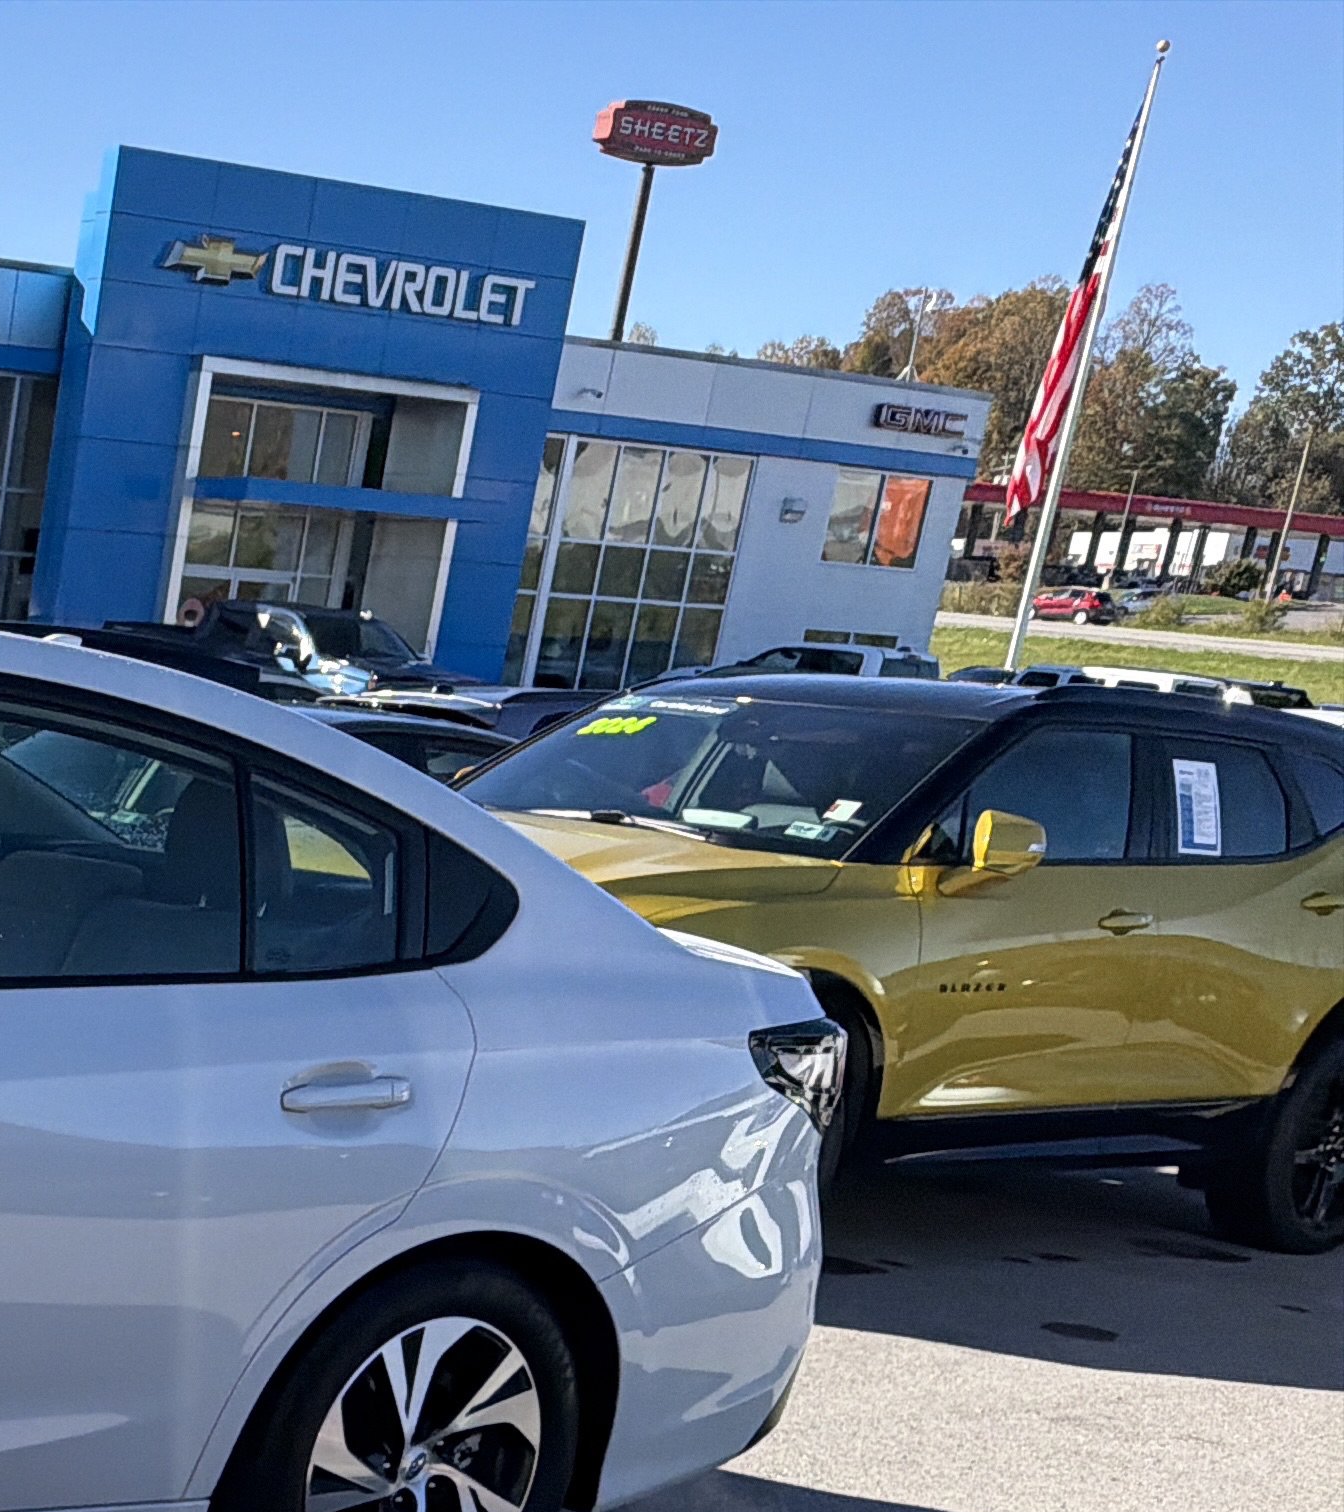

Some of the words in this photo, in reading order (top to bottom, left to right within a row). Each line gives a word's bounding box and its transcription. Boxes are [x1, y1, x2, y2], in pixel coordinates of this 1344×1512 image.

[619, 116, 709, 148] SHEETZ
[271, 244, 536, 326] CHEVROLET
[875, 403, 969, 436] GMC
